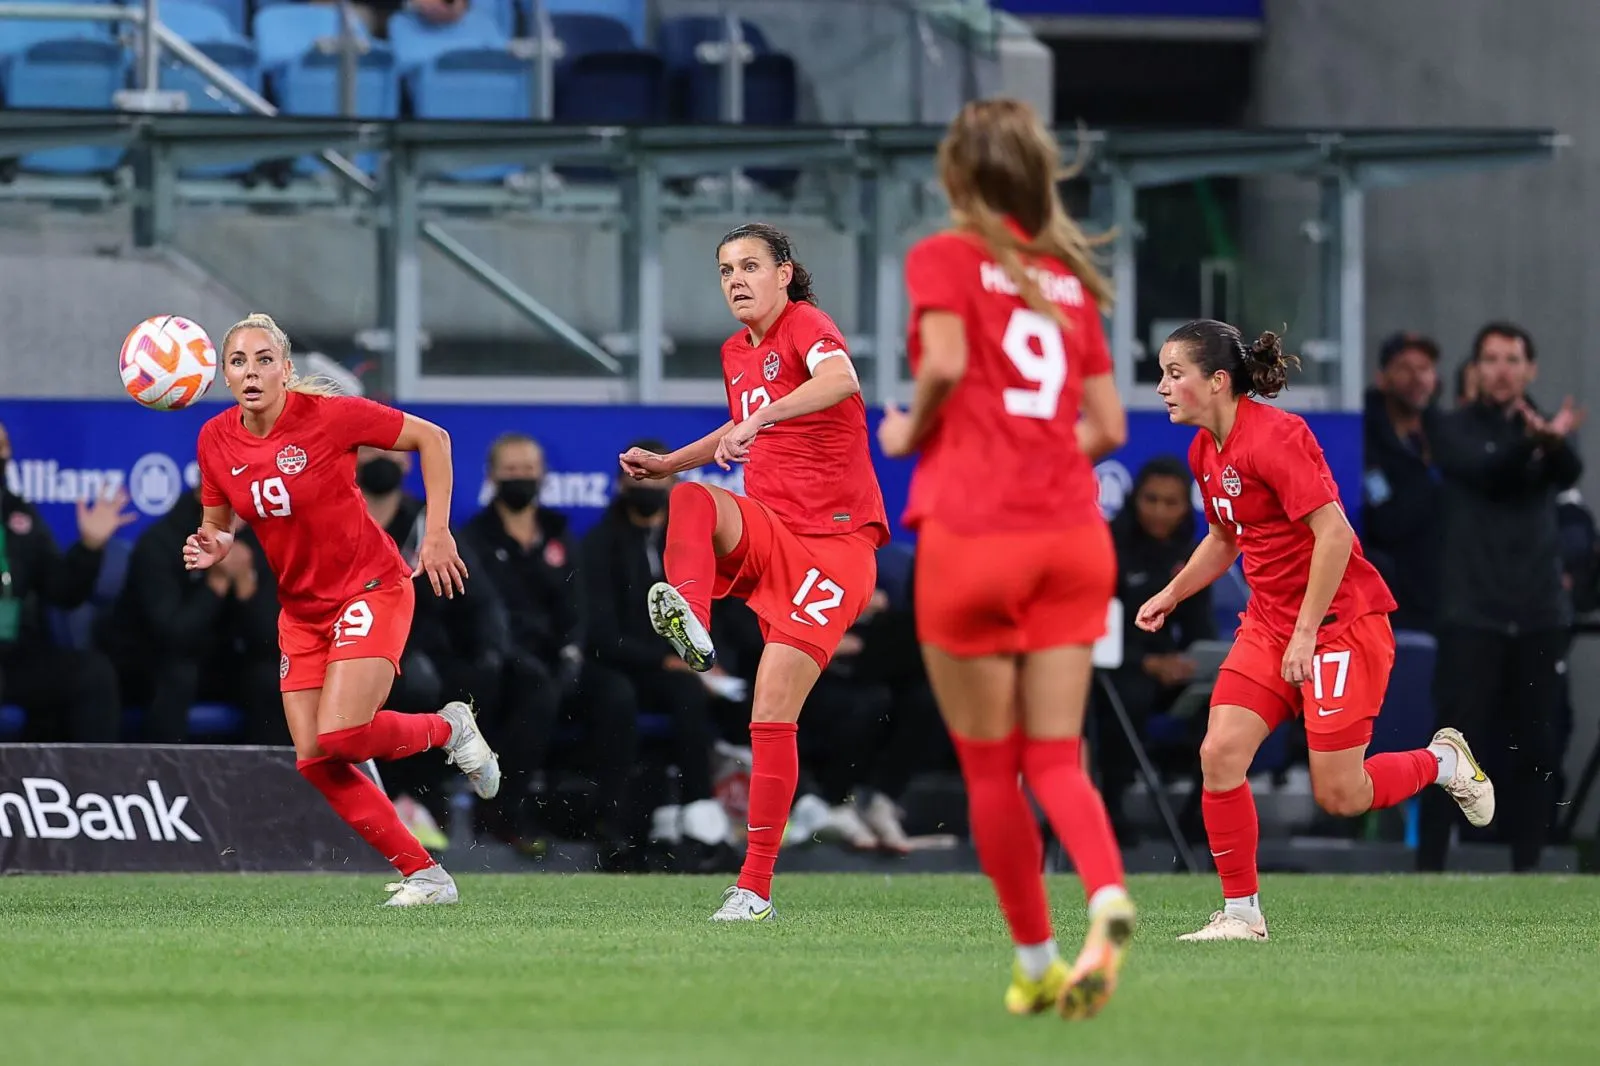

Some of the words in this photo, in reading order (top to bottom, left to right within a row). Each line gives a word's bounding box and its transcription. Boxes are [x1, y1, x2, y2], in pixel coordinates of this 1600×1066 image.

[1001, 308, 1067, 420] 9
[278, 456, 305, 465] CANADA
[250, 476, 292, 518] 19
[1212, 497, 1243, 535] 17
[792, 567, 845, 627] 12
[1312, 650, 1350, 700] 17
